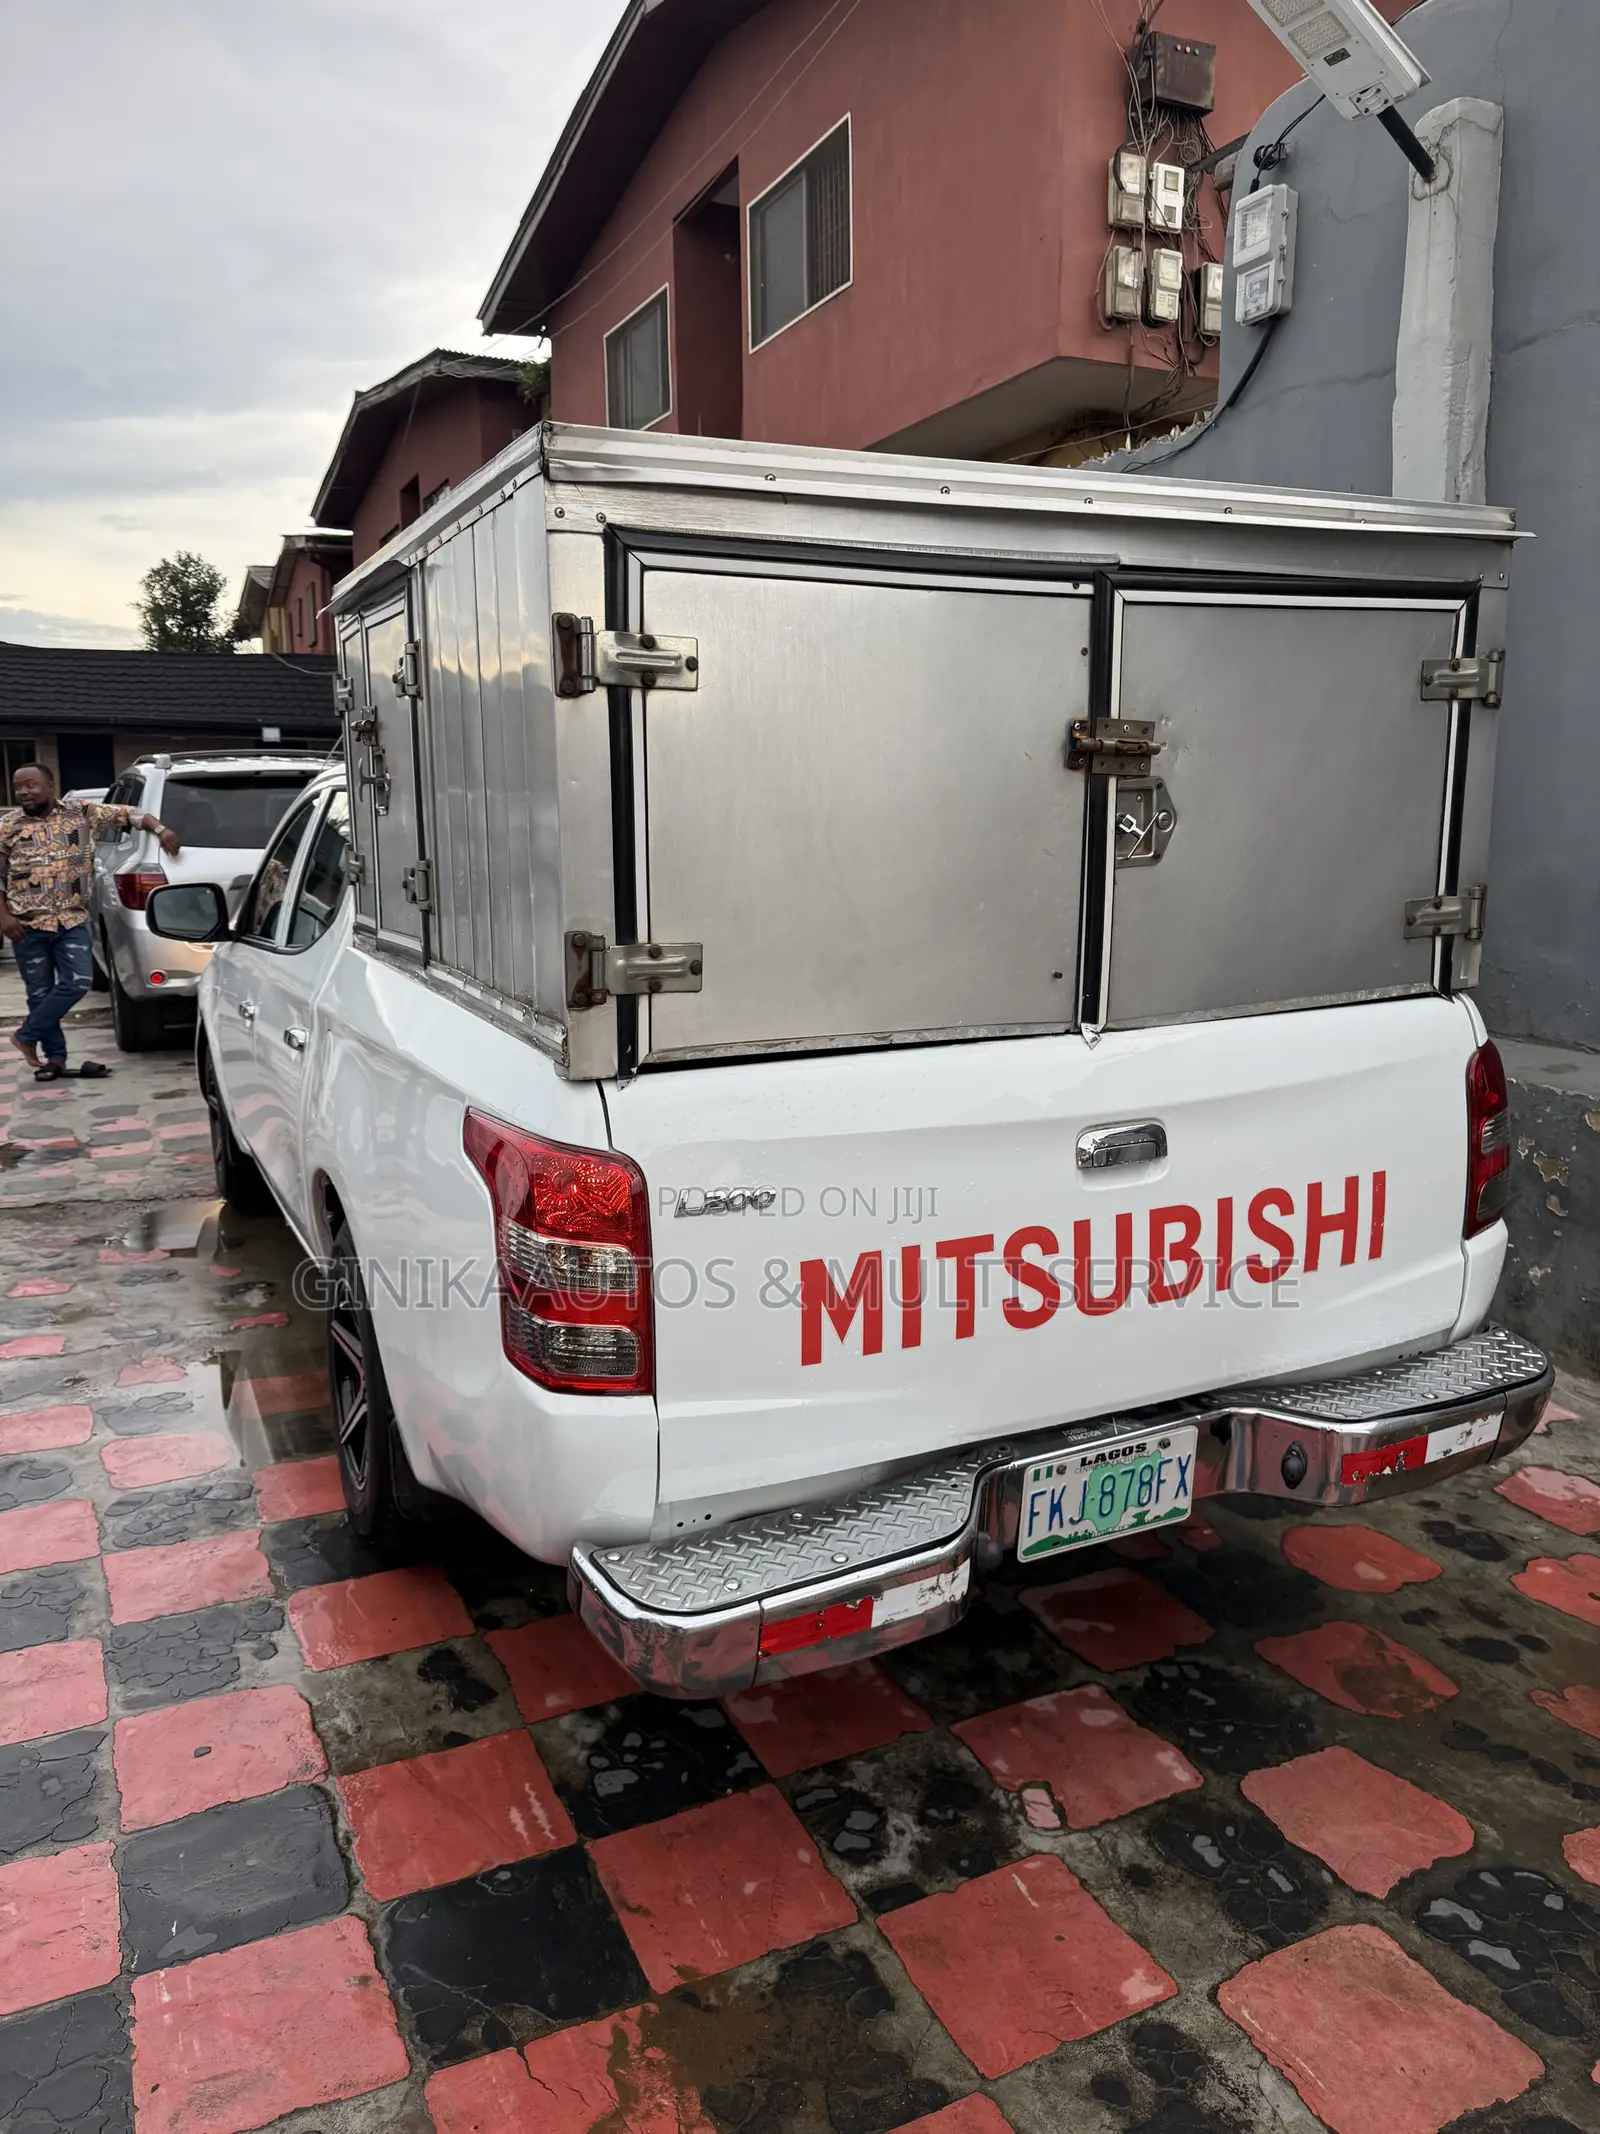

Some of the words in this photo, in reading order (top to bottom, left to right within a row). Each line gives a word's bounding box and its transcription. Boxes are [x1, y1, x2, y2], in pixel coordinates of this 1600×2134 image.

[674, 1184, 777, 1218] L200
[800, 1170, 1386, 1366] MITSUBISHI
[1080, 1442, 1148, 1467] LAGOS
